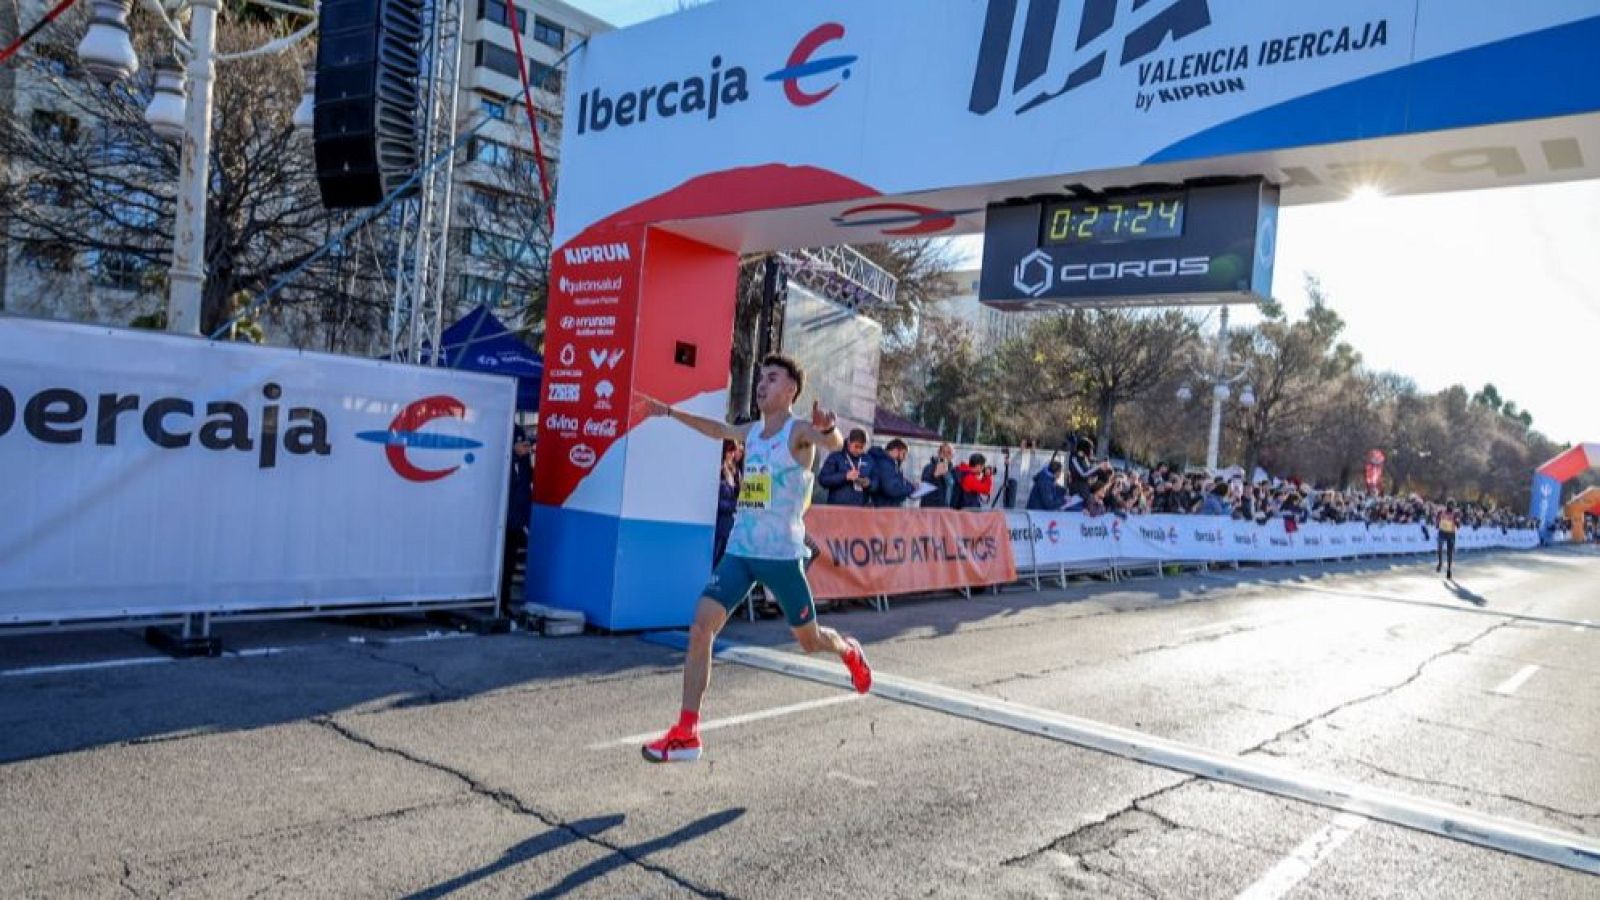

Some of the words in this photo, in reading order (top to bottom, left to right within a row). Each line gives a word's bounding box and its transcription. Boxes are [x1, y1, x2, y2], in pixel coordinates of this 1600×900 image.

[1138, 45, 1248, 87] VALENCIA
[1257, 19, 1388, 66] IBERCAJA
[577, 55, 749, 135] Ibercaja
[1136, 91, 1155, 112] by
[1159, 77, 1245, 103] KIPRUN
[1050, 199, 1181, 240] 0:27:24
[564, 242, 630, 265] KIPRUN
[1060, 256, 1211, 281] COROS
[827, 537, 905, 567] WORLD
[911, 535, 998, 562] ATHLETICS
